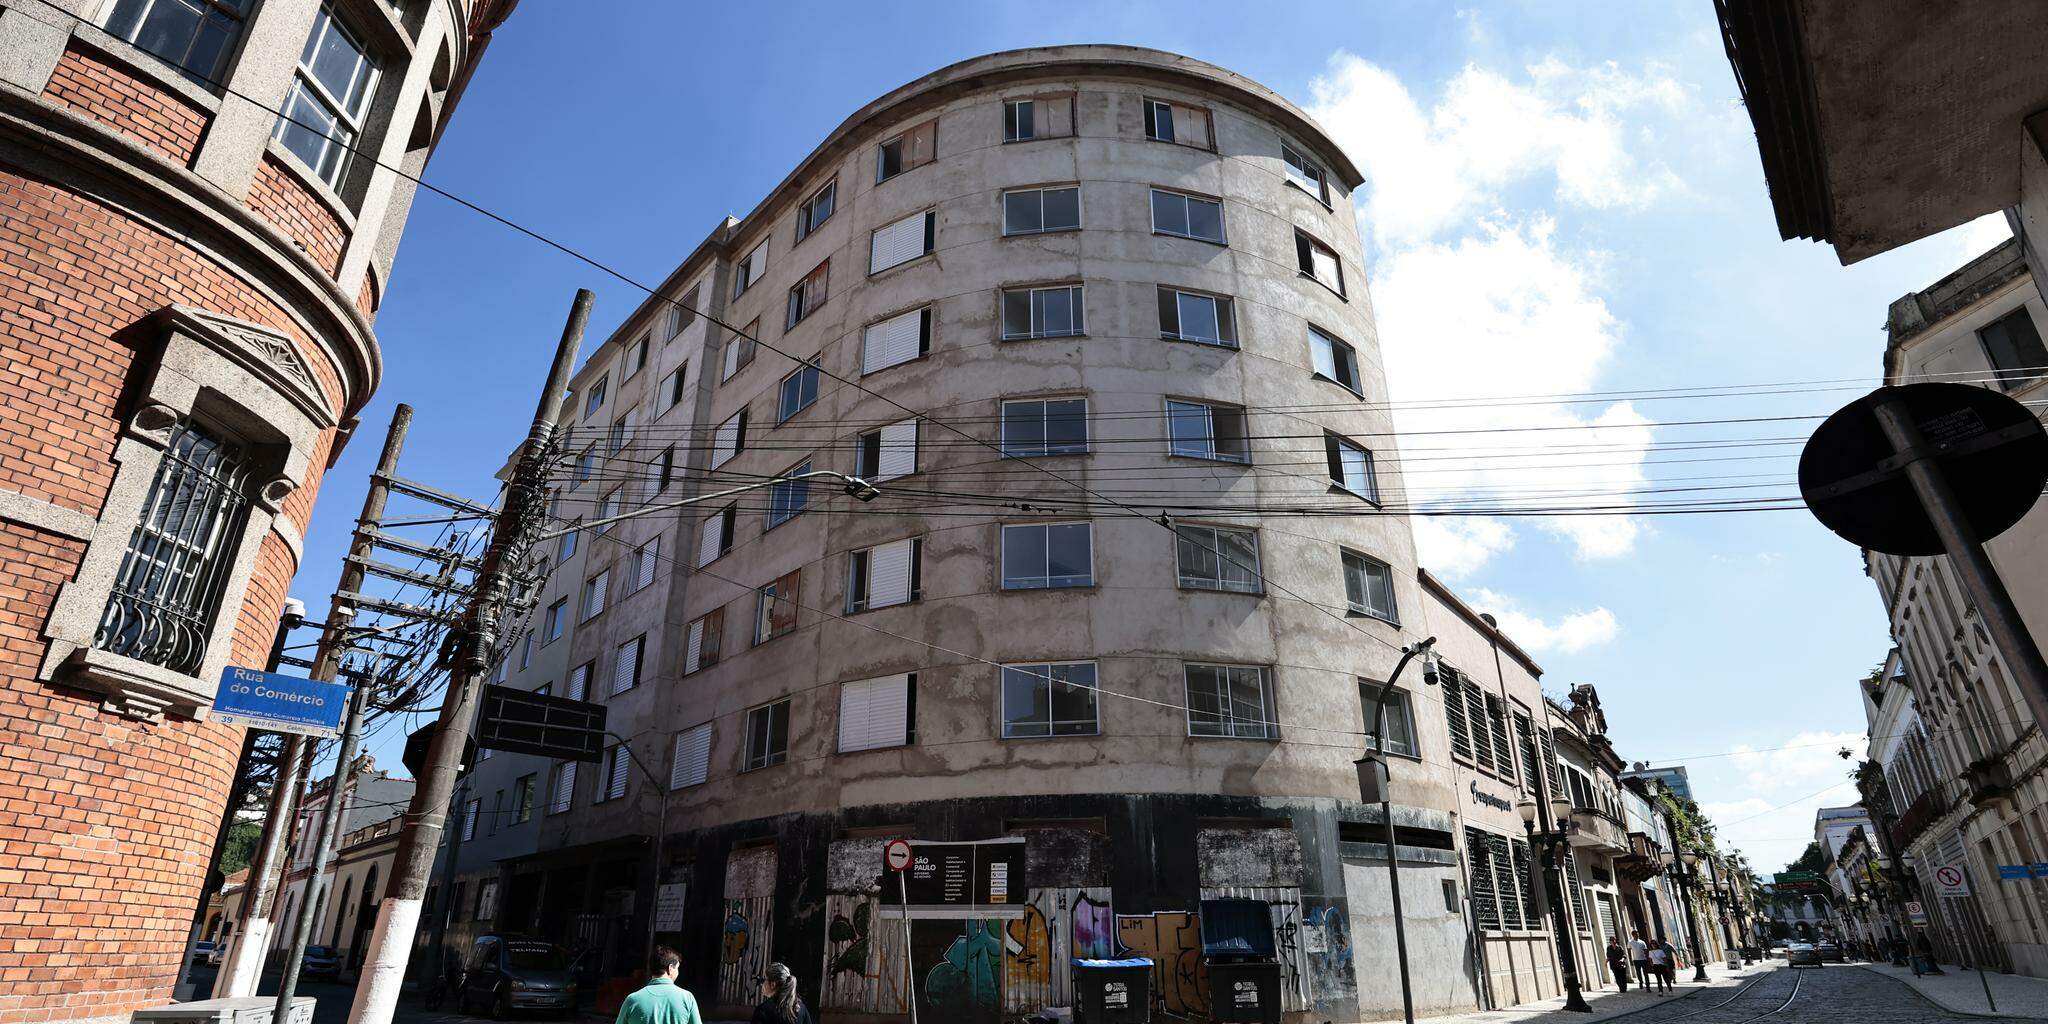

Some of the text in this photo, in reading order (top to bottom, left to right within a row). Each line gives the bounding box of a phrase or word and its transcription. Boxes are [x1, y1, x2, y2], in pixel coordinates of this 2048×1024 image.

[233, 668, 264, 683] Rua
[230, 682, 325, 706] do Comércio
[221, 716, 233, 724] 39
[321, 729, 331, 737] 71
[914, 856, 929, 865] SÃO
